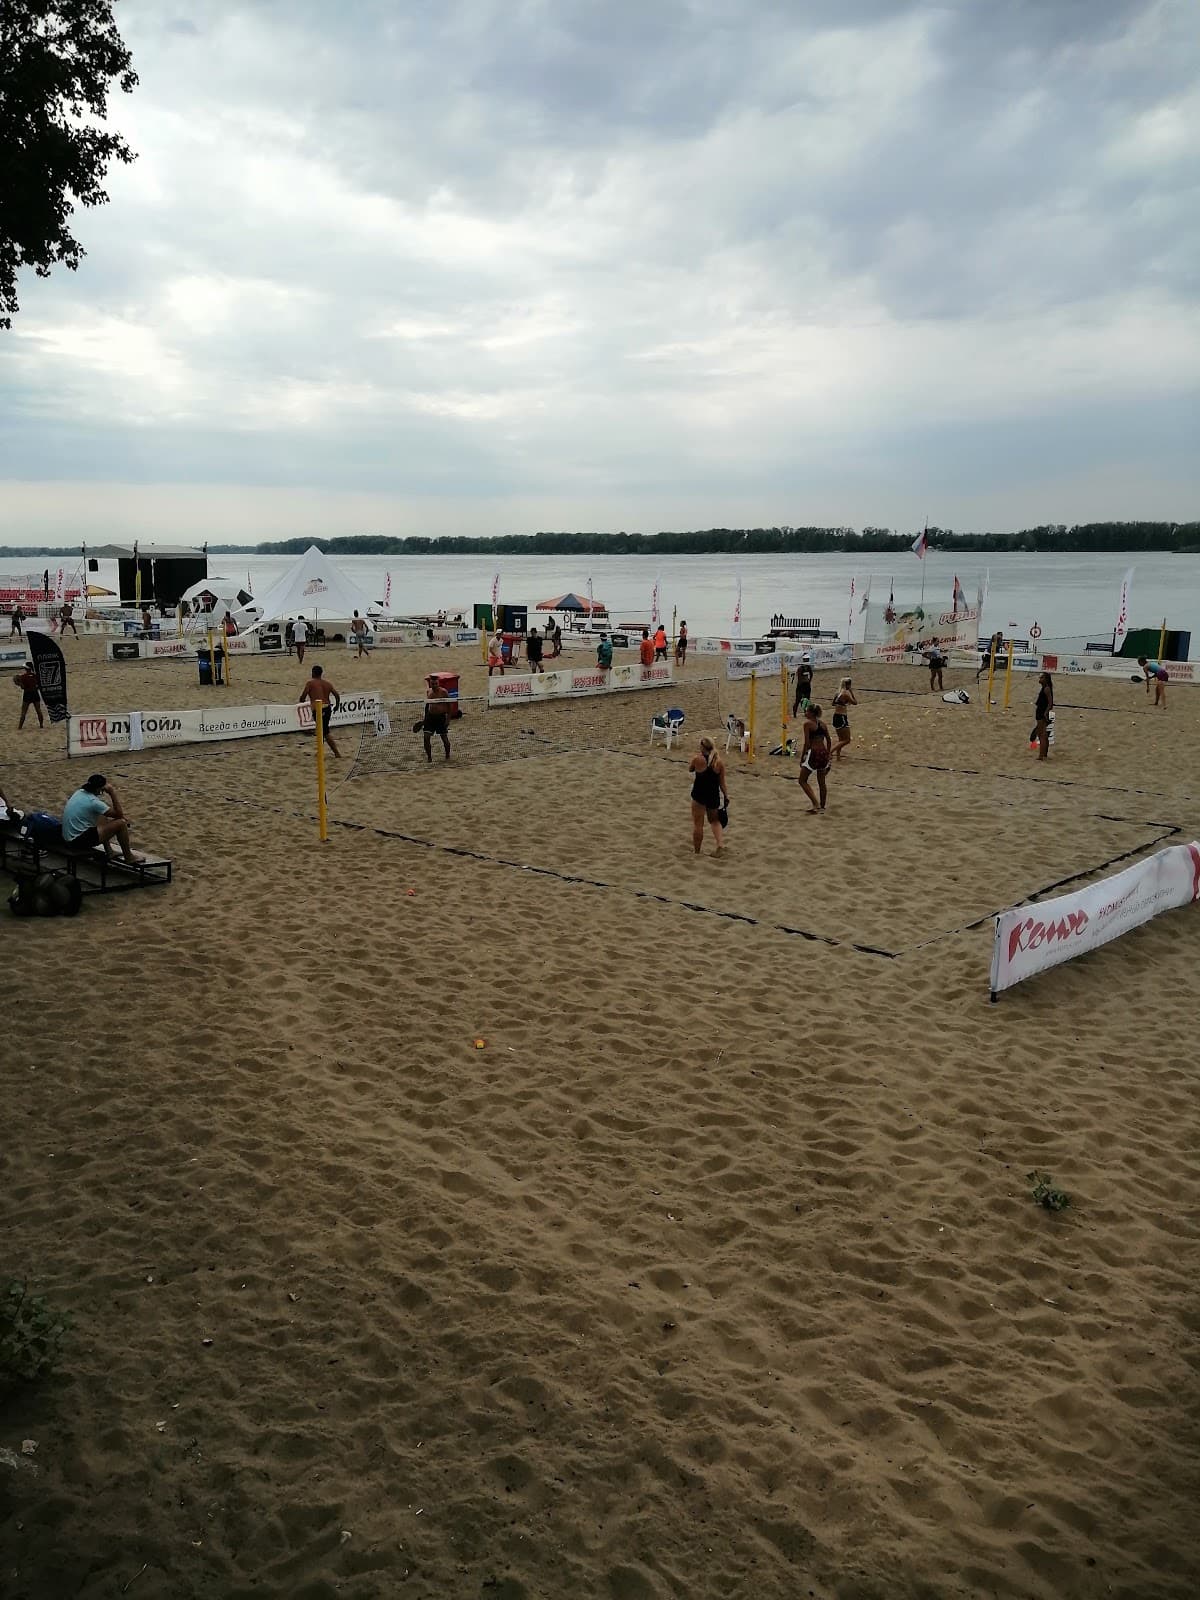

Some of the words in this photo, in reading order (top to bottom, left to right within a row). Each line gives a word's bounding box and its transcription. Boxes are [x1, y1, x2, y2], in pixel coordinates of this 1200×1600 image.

[334, 697, 375, 716] КОЙЛ
[199, 718, 231, 732] Всегда
[233, 721, 240, 729] в
[241, 716, 287, 731] движении
